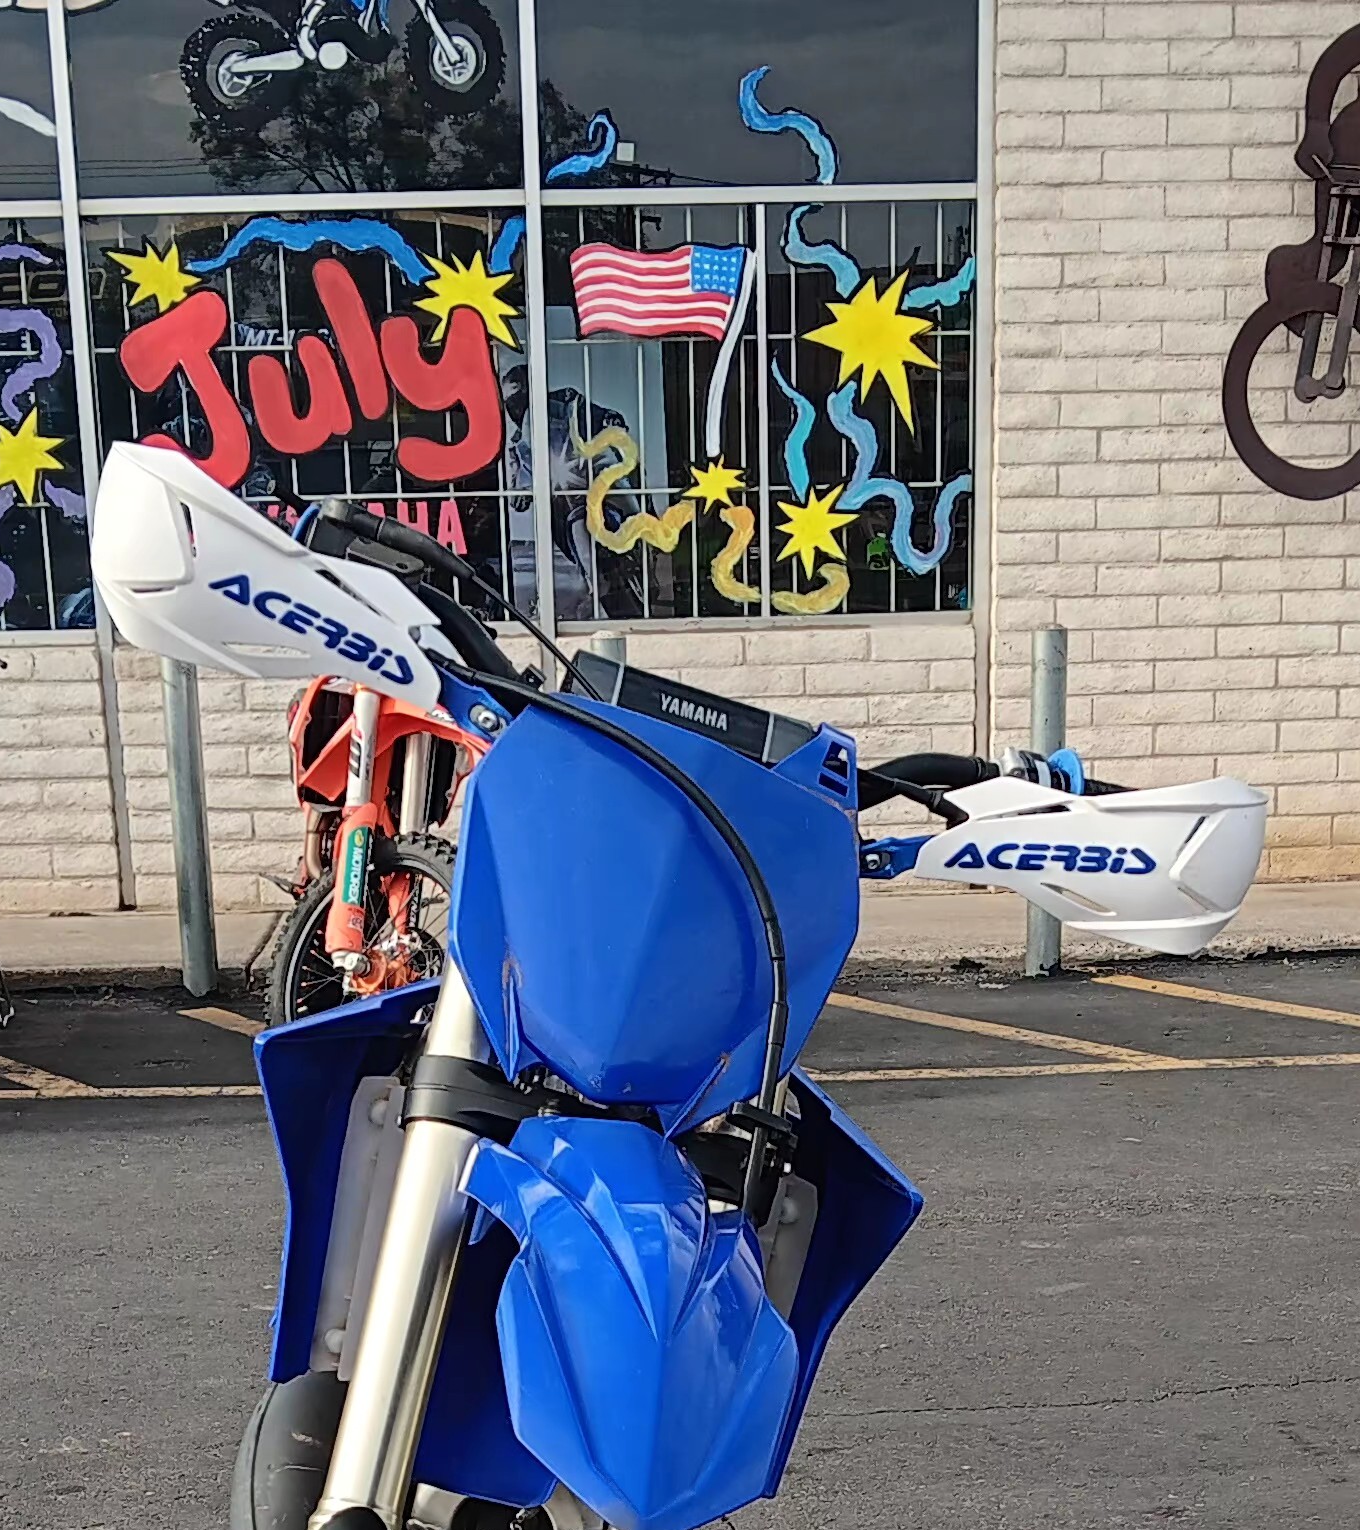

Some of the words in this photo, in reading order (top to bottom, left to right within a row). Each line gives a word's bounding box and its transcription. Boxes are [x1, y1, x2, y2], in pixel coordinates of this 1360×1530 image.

[121, 259, 503, 489] July
[661, 692, 728, 731] YAMAHA
[346, 847, 364, 905] MOTOREX
